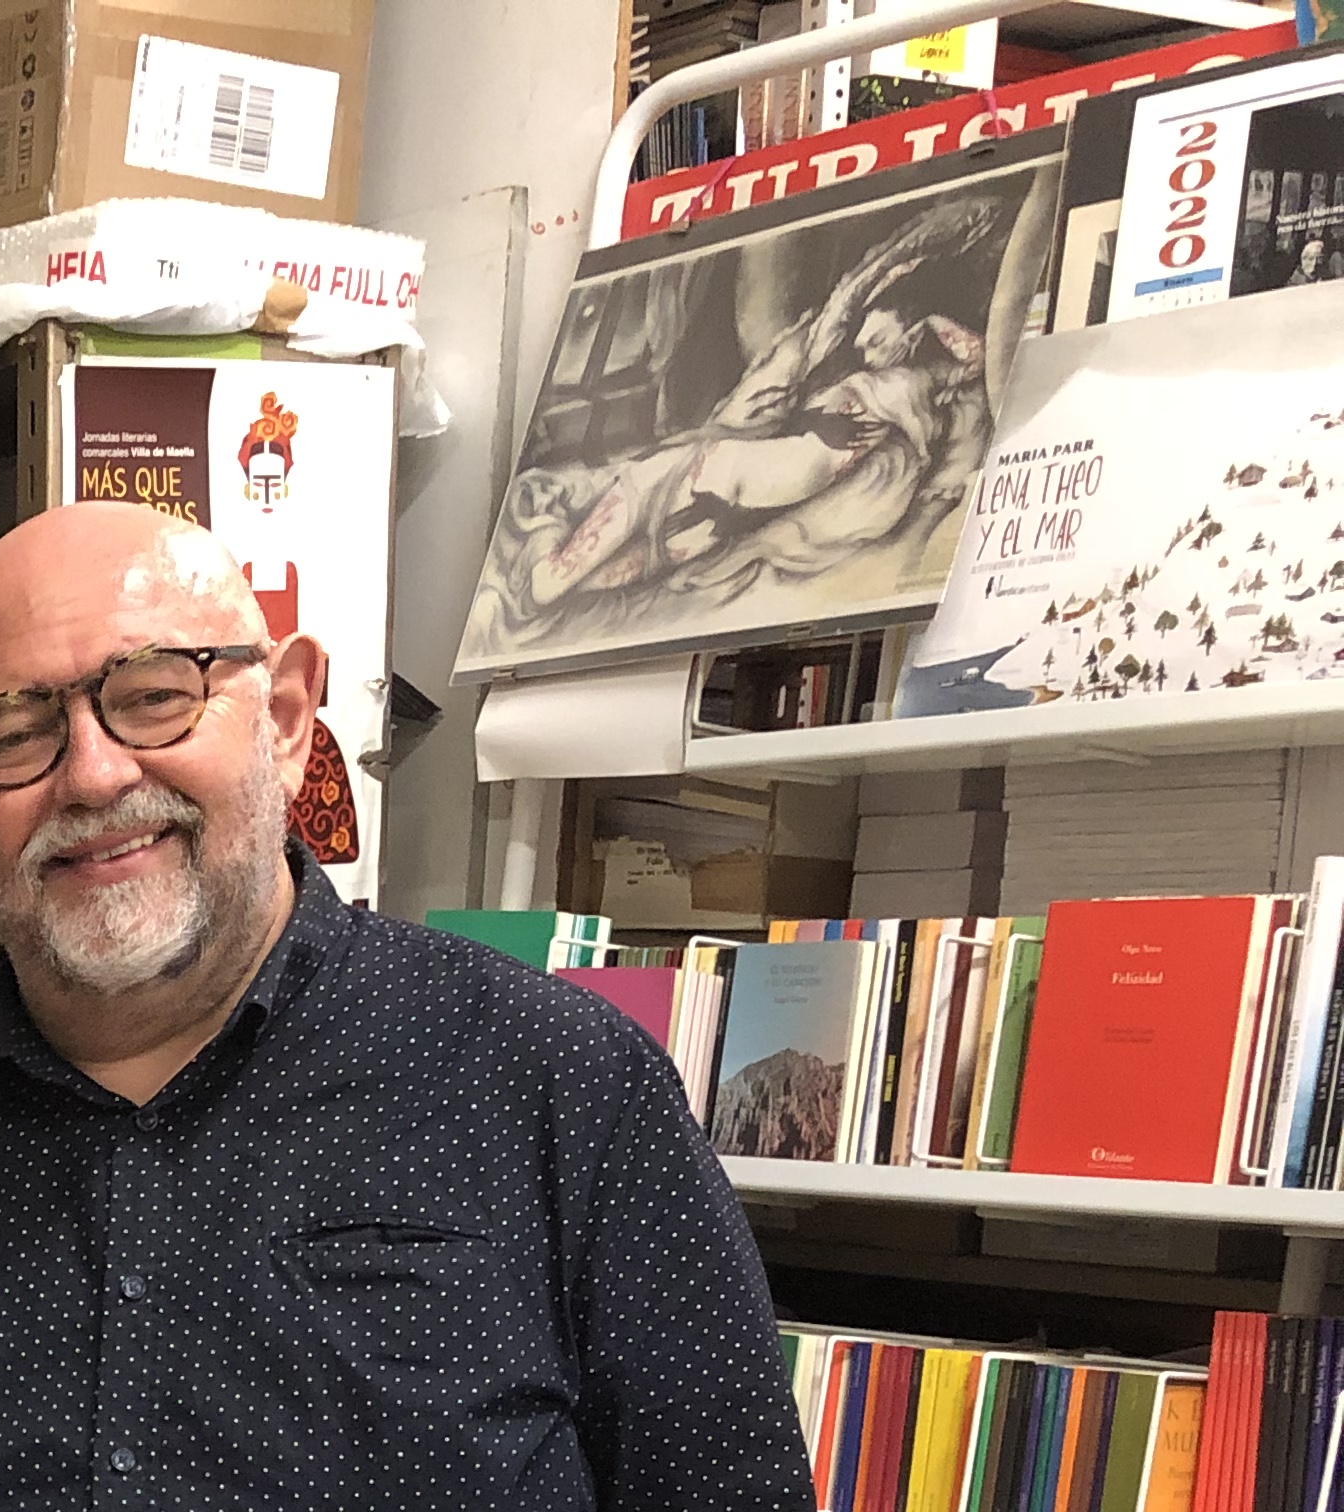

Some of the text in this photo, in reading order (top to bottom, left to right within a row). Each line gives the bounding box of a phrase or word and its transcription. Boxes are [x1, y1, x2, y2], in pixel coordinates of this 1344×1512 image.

[1158, 120, 1218, 269] 2020
[329, 265, 389, 307] FULL
[81, 431, 157, 444] Jornadas literarias
[82, 447, 129, 458] comarcales
[130, 446, 151, 458] Villa
[152, 446, 165, 457] de
[997, 438, 1095, 468] MARIA PARR
[81, 461, 183, 502] MÁS QUE
[975, 520, 995, 561] Y
[1033, 508, 1083, 551] MAR
